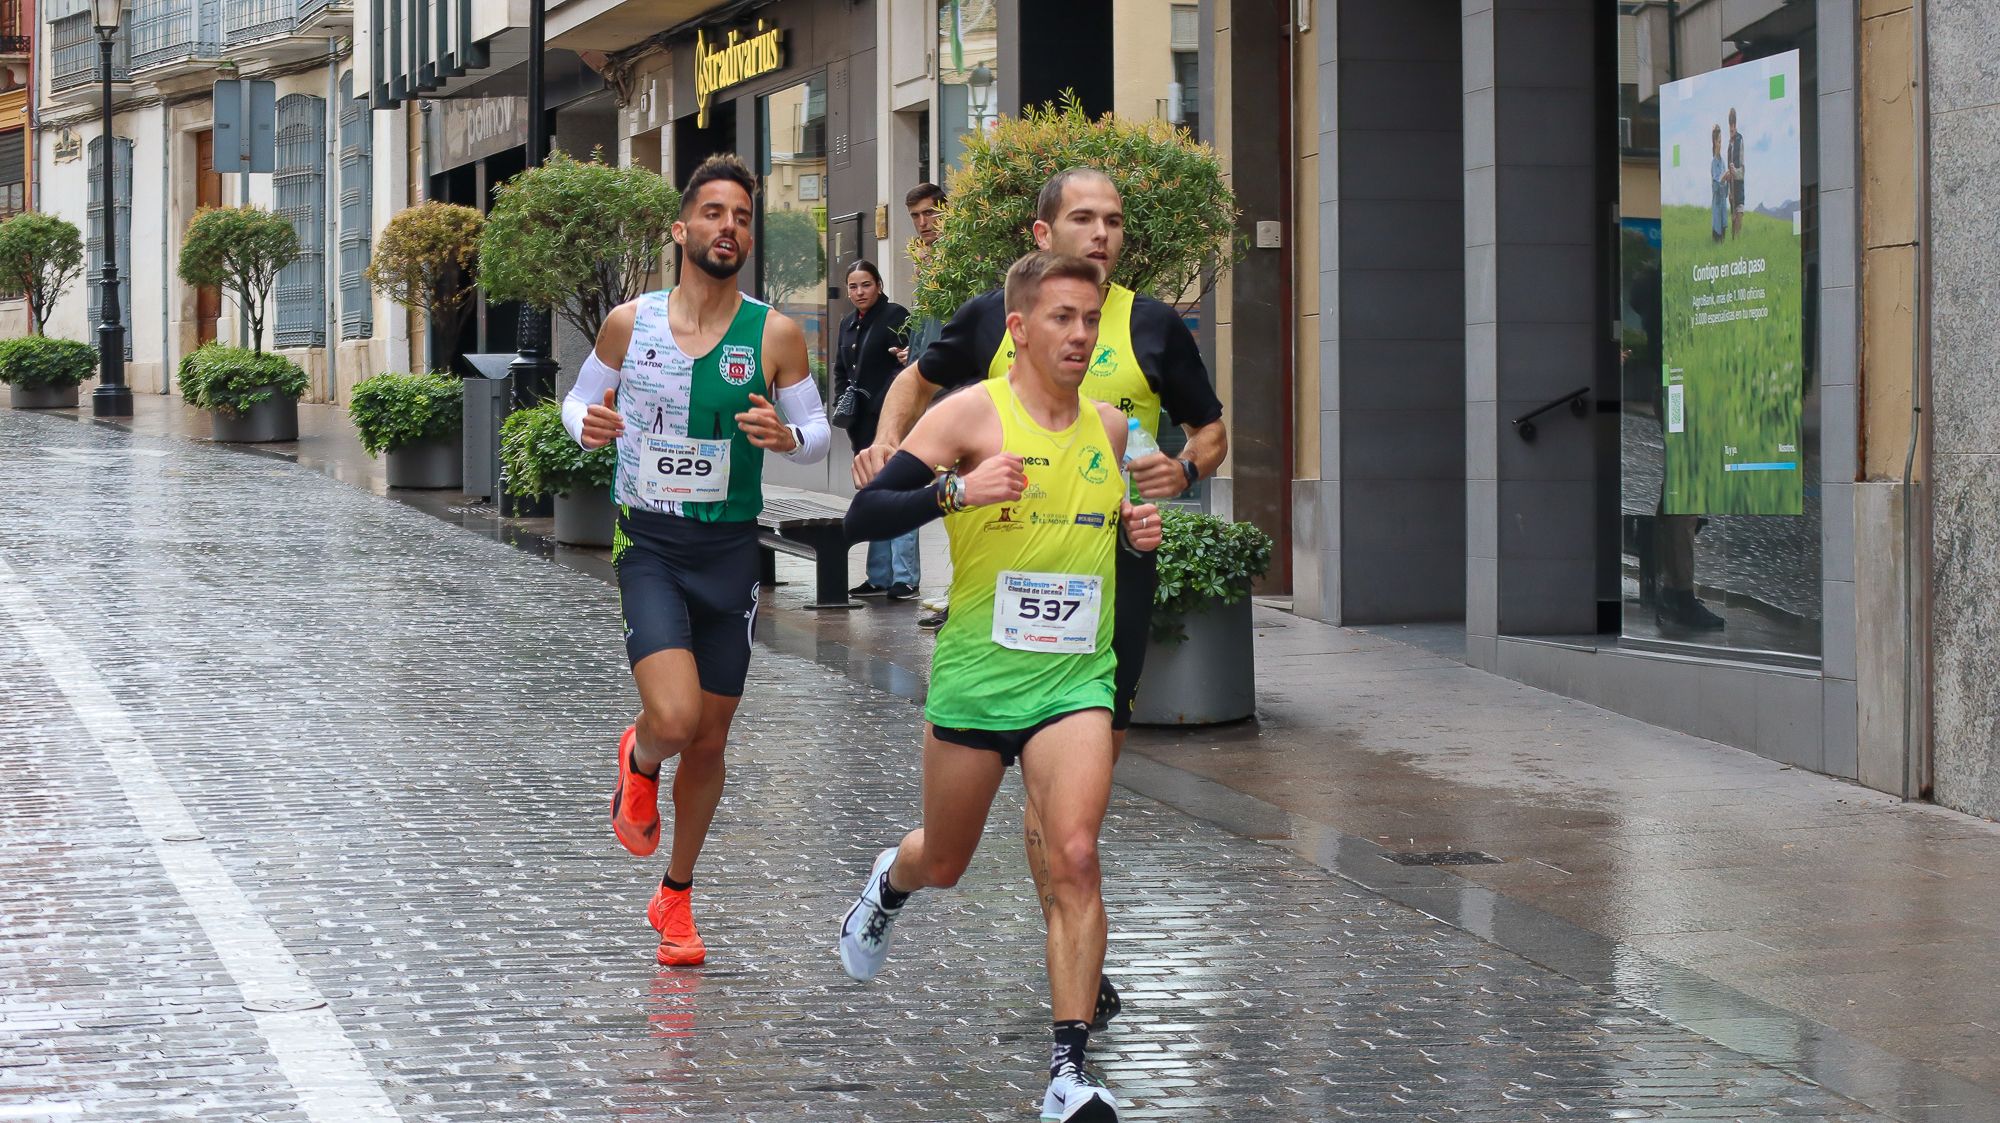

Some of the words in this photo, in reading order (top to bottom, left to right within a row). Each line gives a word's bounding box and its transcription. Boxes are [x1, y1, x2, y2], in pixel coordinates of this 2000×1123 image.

[1693, 262, 1720, 284] Contigo
[1720, 264, 1730, 278] en
[1730, 256, 1747, 276] cada
[1748, 258, 1766, 278] paso
[1726, 289, 1734, 302] de
[1747, 286, 1766, 300] oficinas
[1708, 310, 1736, 324] especialistas
[1749, 305, 1769, 321] negocio
[637, 360, 662, 369] VIATOR
[657, 457, 713, 477] 629
[1008, 586, 1030, 594] Ciudad
[1018, 597, 1081, 622] 537
